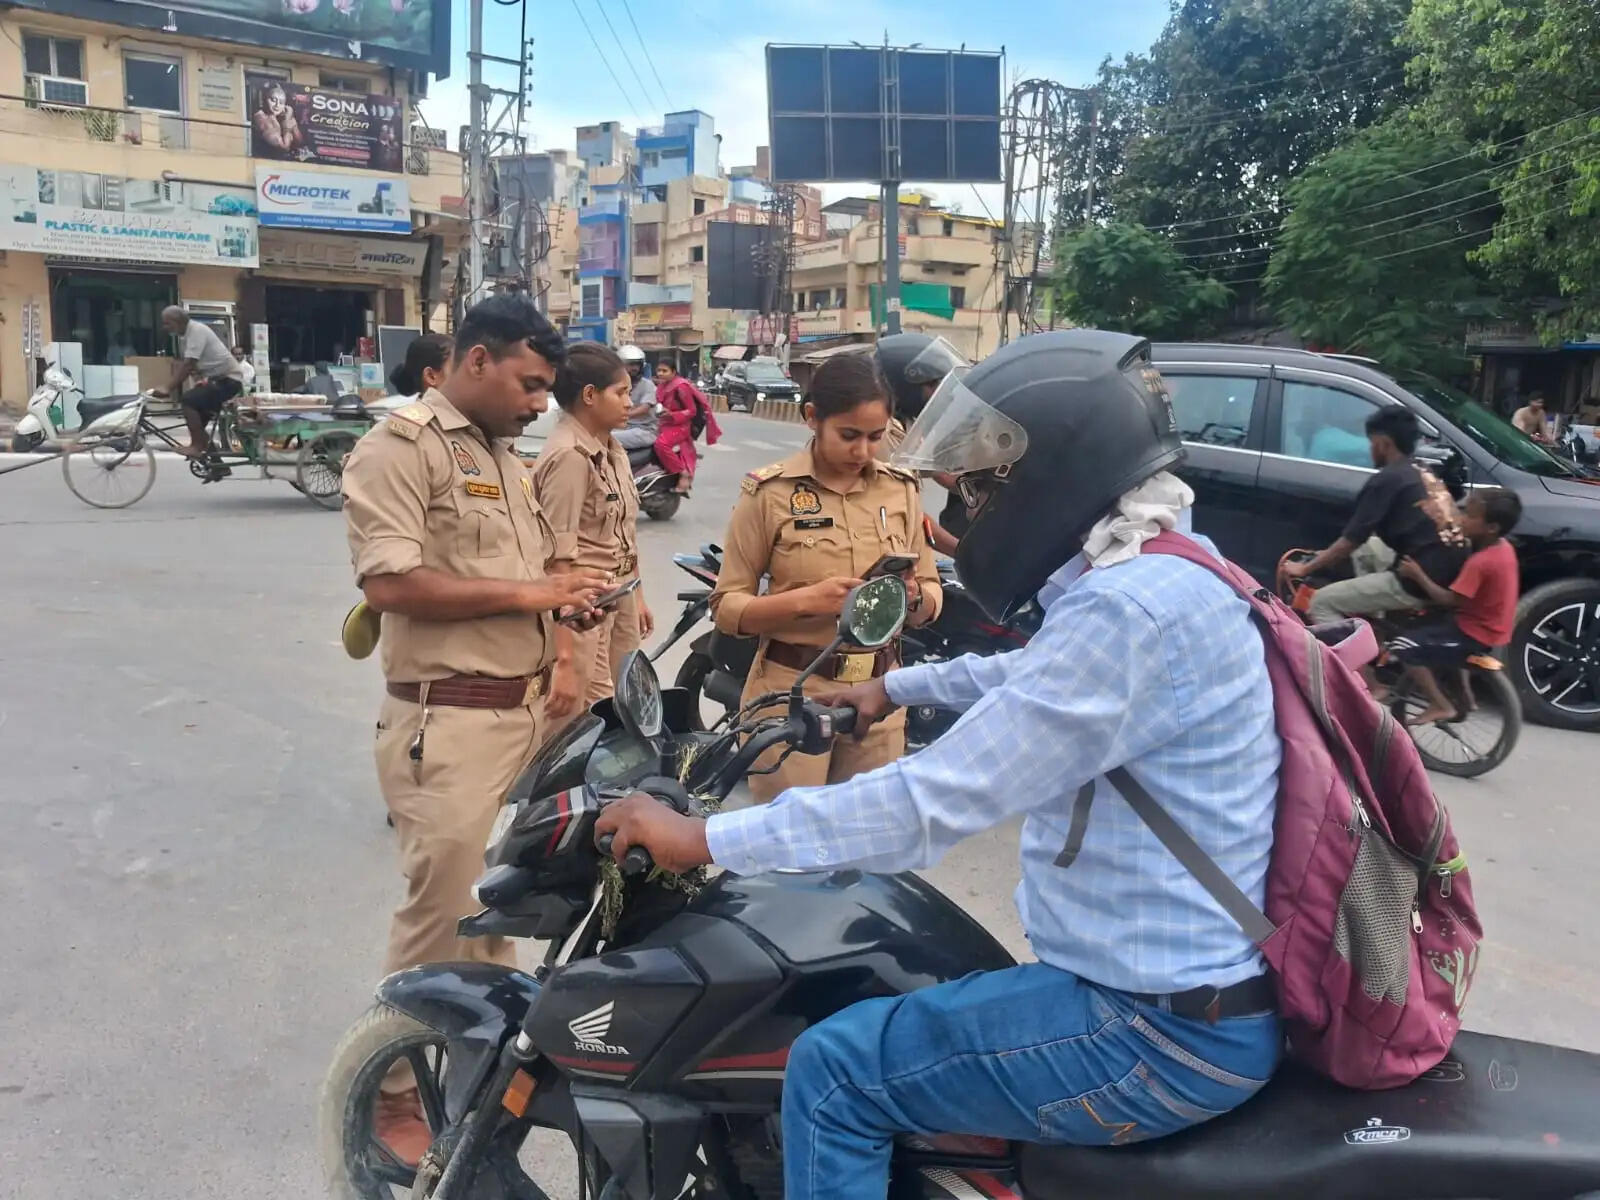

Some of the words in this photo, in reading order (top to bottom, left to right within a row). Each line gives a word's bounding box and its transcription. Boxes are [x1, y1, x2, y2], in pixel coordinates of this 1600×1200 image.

[312, 94, 369, 116] SONA
[310, 113, 370, 130] Creation
[269, 183, 351, 200] MICROTEK
[45, 220, 97, 233] PLASTIC
[101, 226, 109, 234] &
[113, 226, 212, 242] SANITARYWARE
[573, 1041, 630, 1055] HONDA
